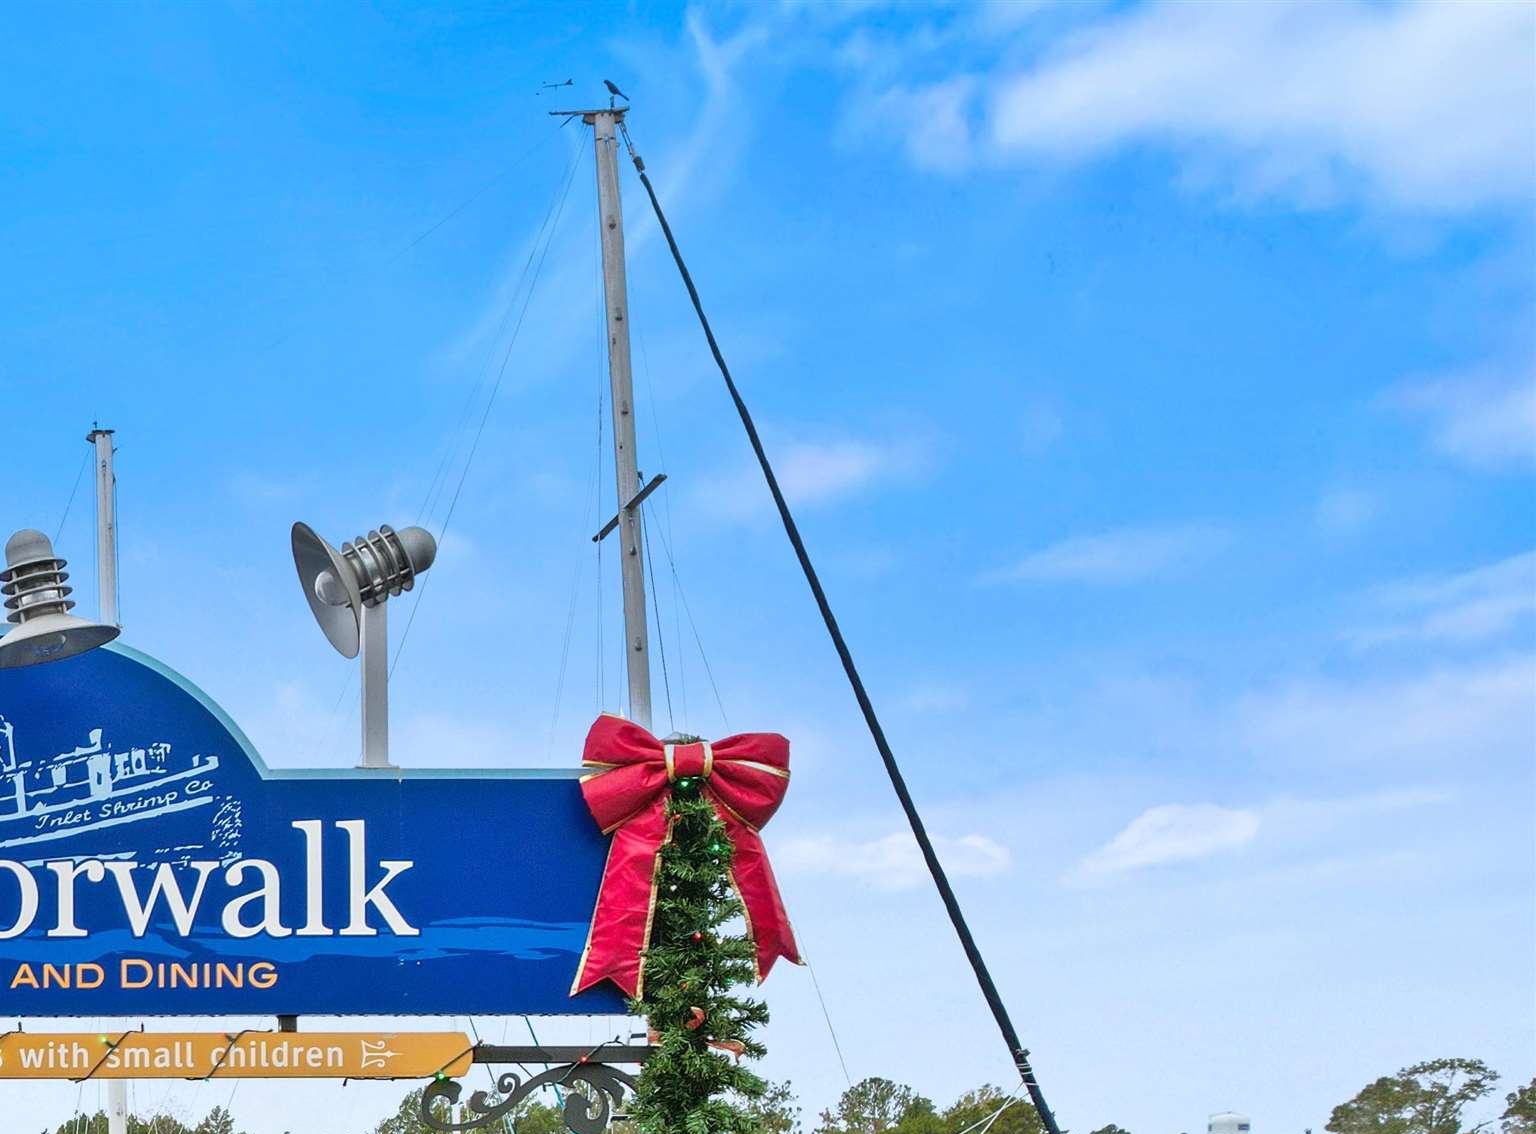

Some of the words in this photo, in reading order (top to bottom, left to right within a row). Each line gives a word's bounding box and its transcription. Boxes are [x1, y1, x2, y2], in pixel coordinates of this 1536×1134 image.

[35, 811, 92, 829] Inlet
[99, 791, 178, 817] Shrimp
[19, 1040, 89, 1068] with
[106, 1040, 193, 1068] small
[210, 1039, 344, 1068] children
